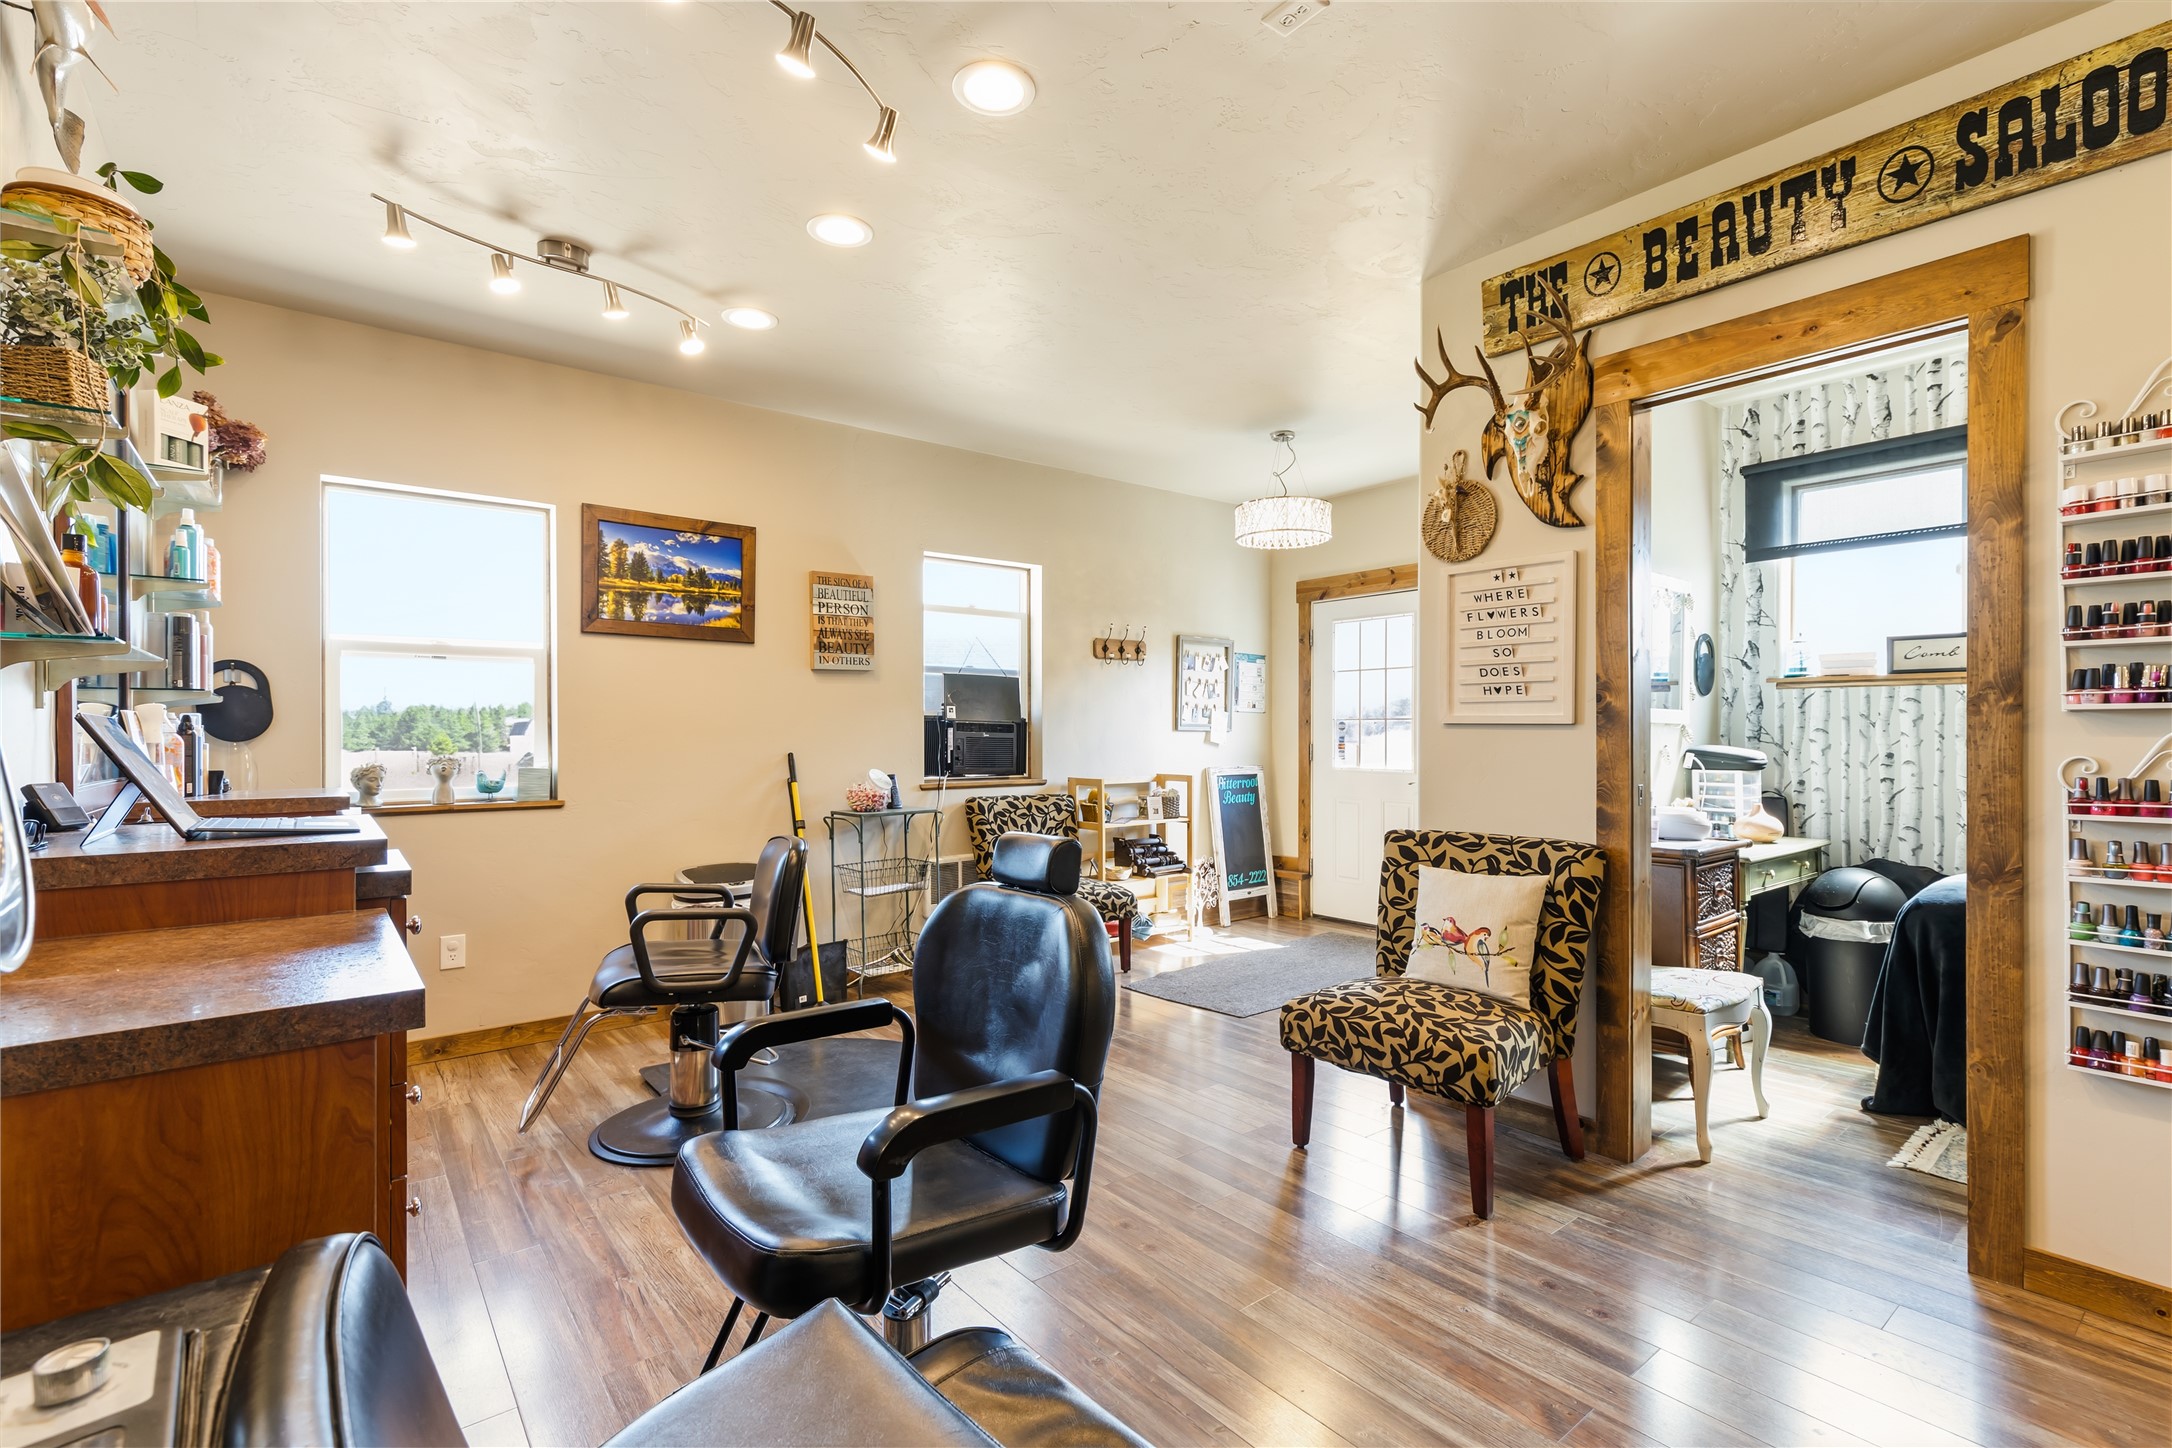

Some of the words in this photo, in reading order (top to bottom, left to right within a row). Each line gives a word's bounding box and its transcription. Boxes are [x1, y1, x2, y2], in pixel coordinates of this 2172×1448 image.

[1499, 260, 1568, 335] THE
[1643, 156, 1856, 292] BEAUTY
[817, 576, 831, 586] THE
[834, 578, 850, 588] SIGN
[852, 579, 861, 589] OF
[863, 580, 869, 589] A
[817, 588, 869, 602] BEAUTIFUL
[1473, 588, 1526, 603] WHERE
[818, 602, 869, 615] PERSON
[817, 616, 826, 625] IS
[827, 616, 848, 626] THAT
[849, 618, 869, 628] THEY
[818, 627, 853, 641] ALWAYS
[854, 629, 870, 641] SEE
[1476, 627, 1528, 640] BLOOM
[818, 640, 870, 655] BEAUTY
[1493, 648, 1512, 658] SO
[1904, 645, 1961, 660] Comb
[819, 655, 830, 665] IN
[831, 656, 871, 666] OTHERS
[1479, 666, 1521, 678] DOES
[1222, 790, 1256, 806] Beauty
[1227, 869, 1267, 888] 854-2222
